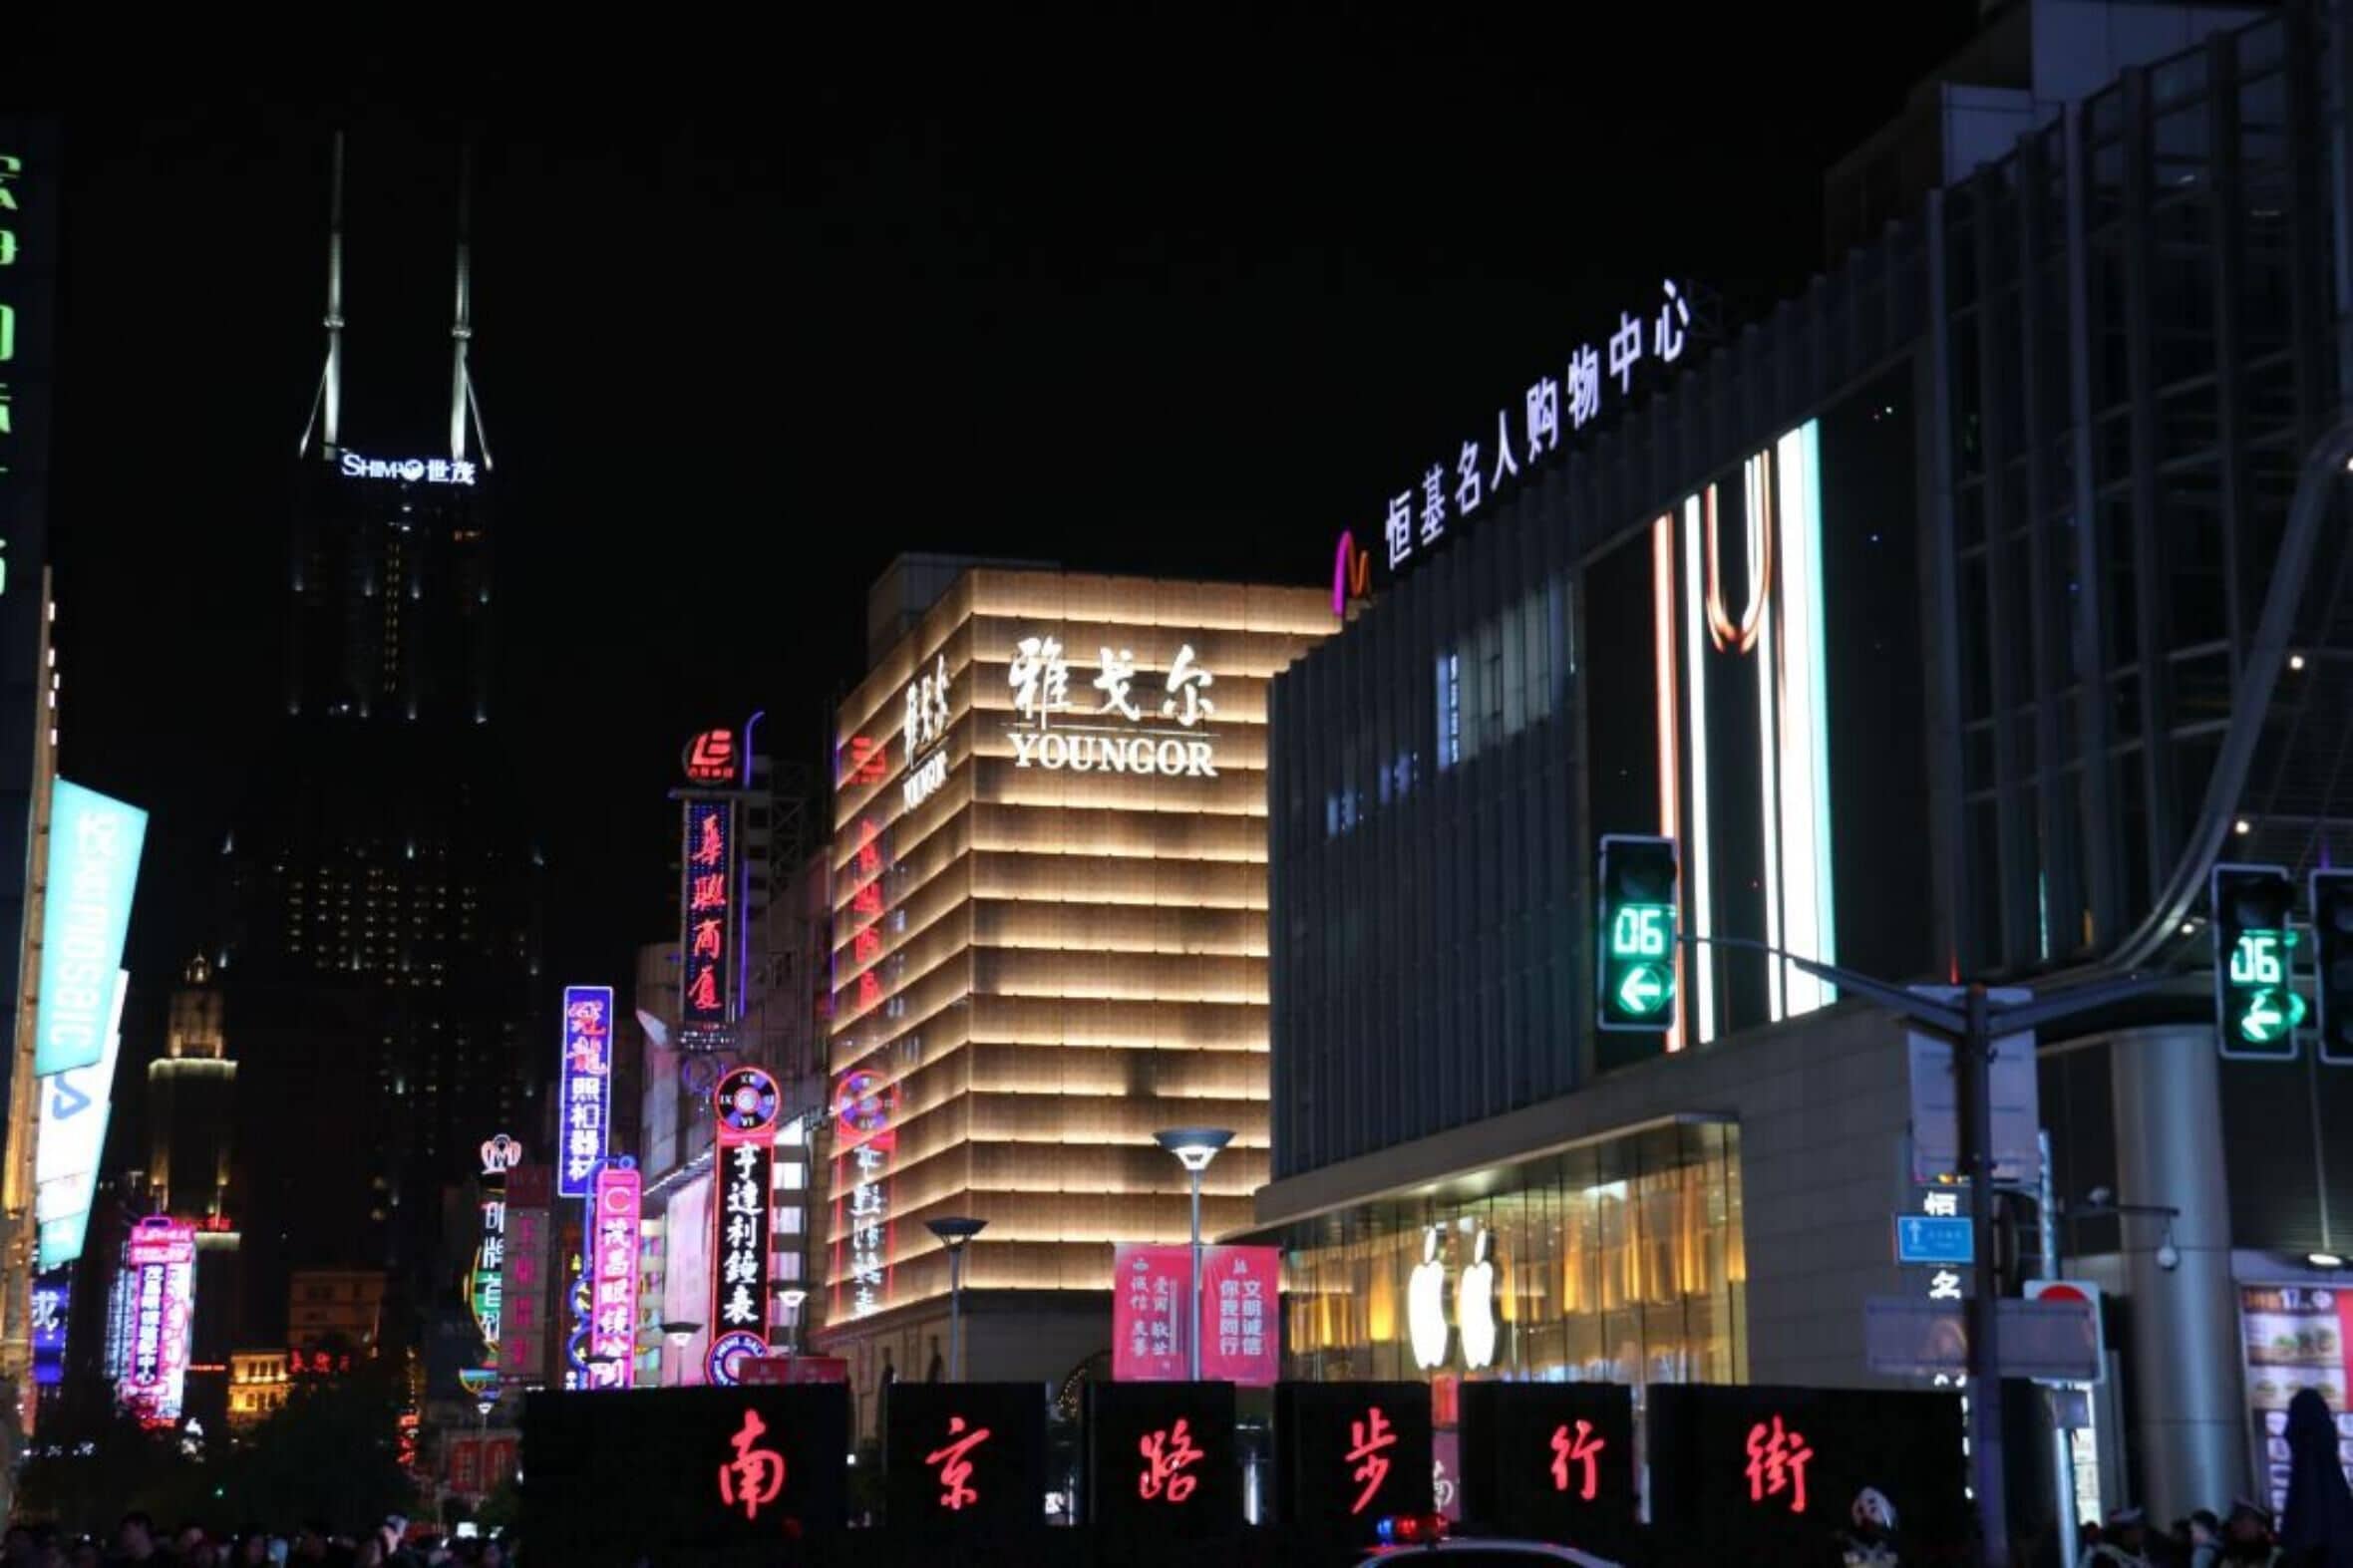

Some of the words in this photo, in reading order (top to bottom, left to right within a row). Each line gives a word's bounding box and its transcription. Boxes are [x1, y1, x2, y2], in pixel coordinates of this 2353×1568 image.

[1385, 279, 1690, 570] 恒基名人购物中心
[428, 460, 476, 484] 世茂
[1009, 635, 1214, 730] 雅戈尔
[1007, 733, 1218, 778] YOUNGOR
[1613, 906, 1664, 955] 06
[2229, 935, 2281, 983] 06
[719, 1408, 1814, 1522] 南京路步行街
